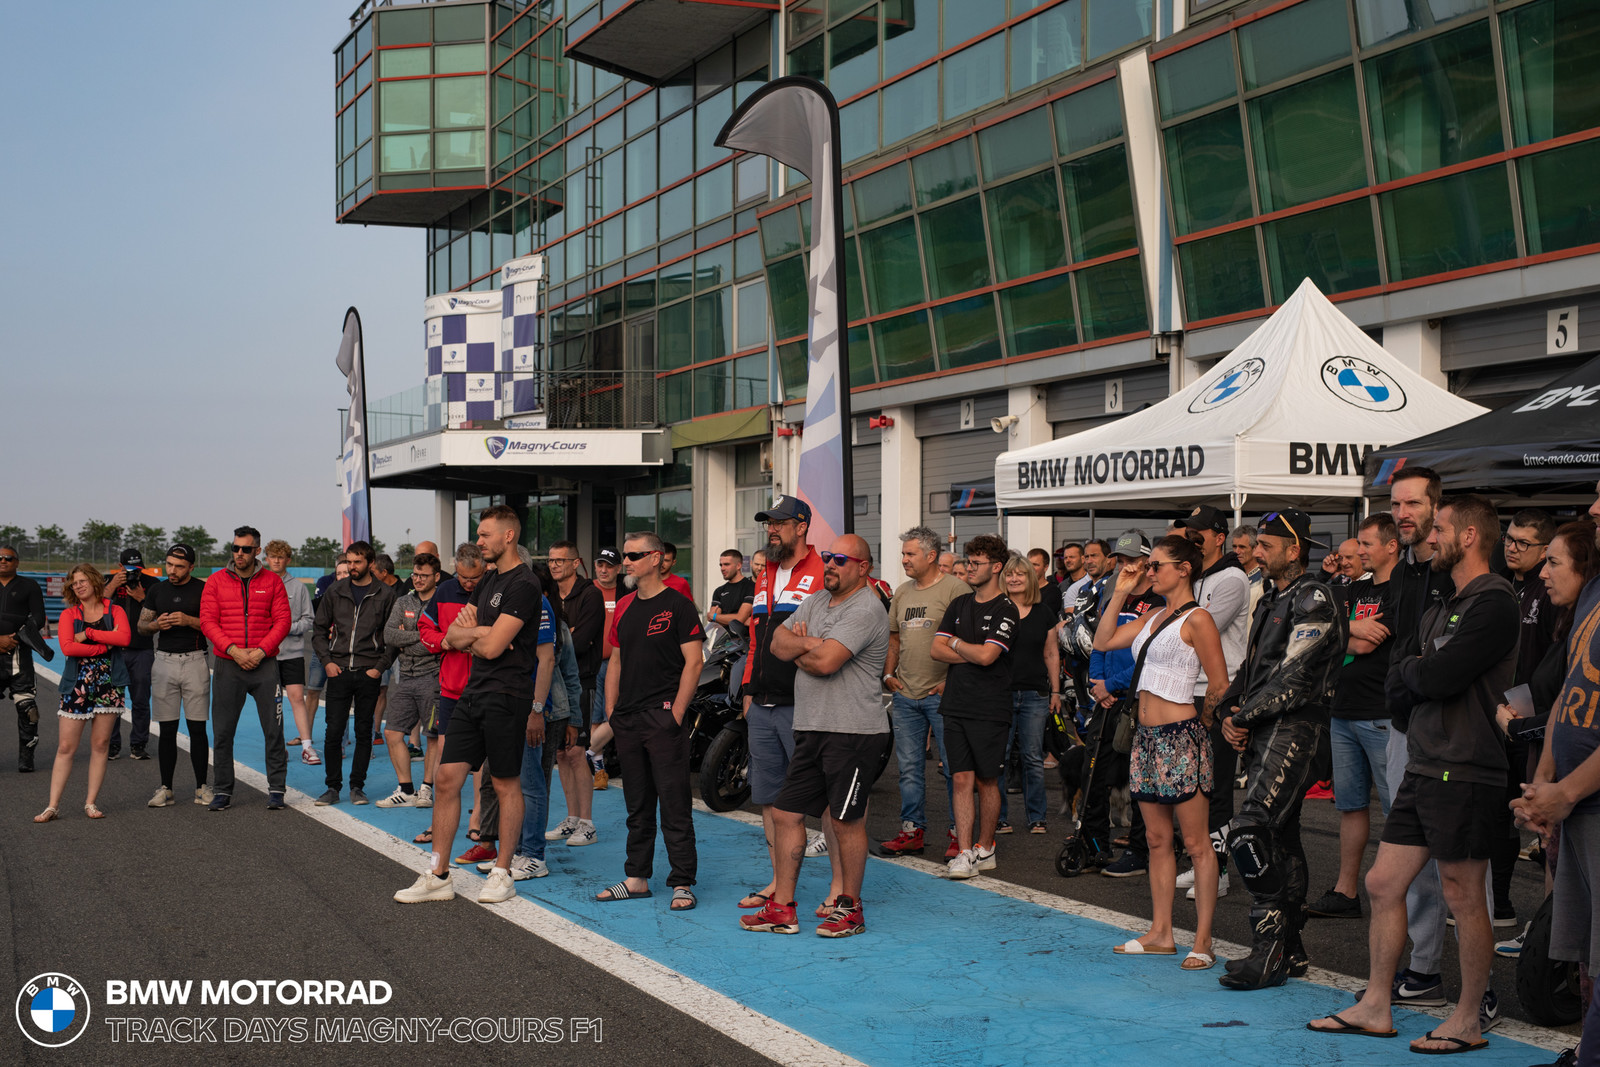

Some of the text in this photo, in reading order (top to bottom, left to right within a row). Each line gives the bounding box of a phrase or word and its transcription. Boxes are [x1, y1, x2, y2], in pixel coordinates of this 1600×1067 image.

[1556, 312, 1569, 348] 5
[1326, 359, 1381, 377] BMW
[1110, 382, 1118, 409] 3
[964, 402, 971, 426] 2
[508, 441, 587, 452] Magny-Cours
[1018, 445, 1205, 490] BMW MOTORRAD
[1523, 453, 1600, 466] bmc-moto.com
[905, 606, 927, 621] DRIVE
